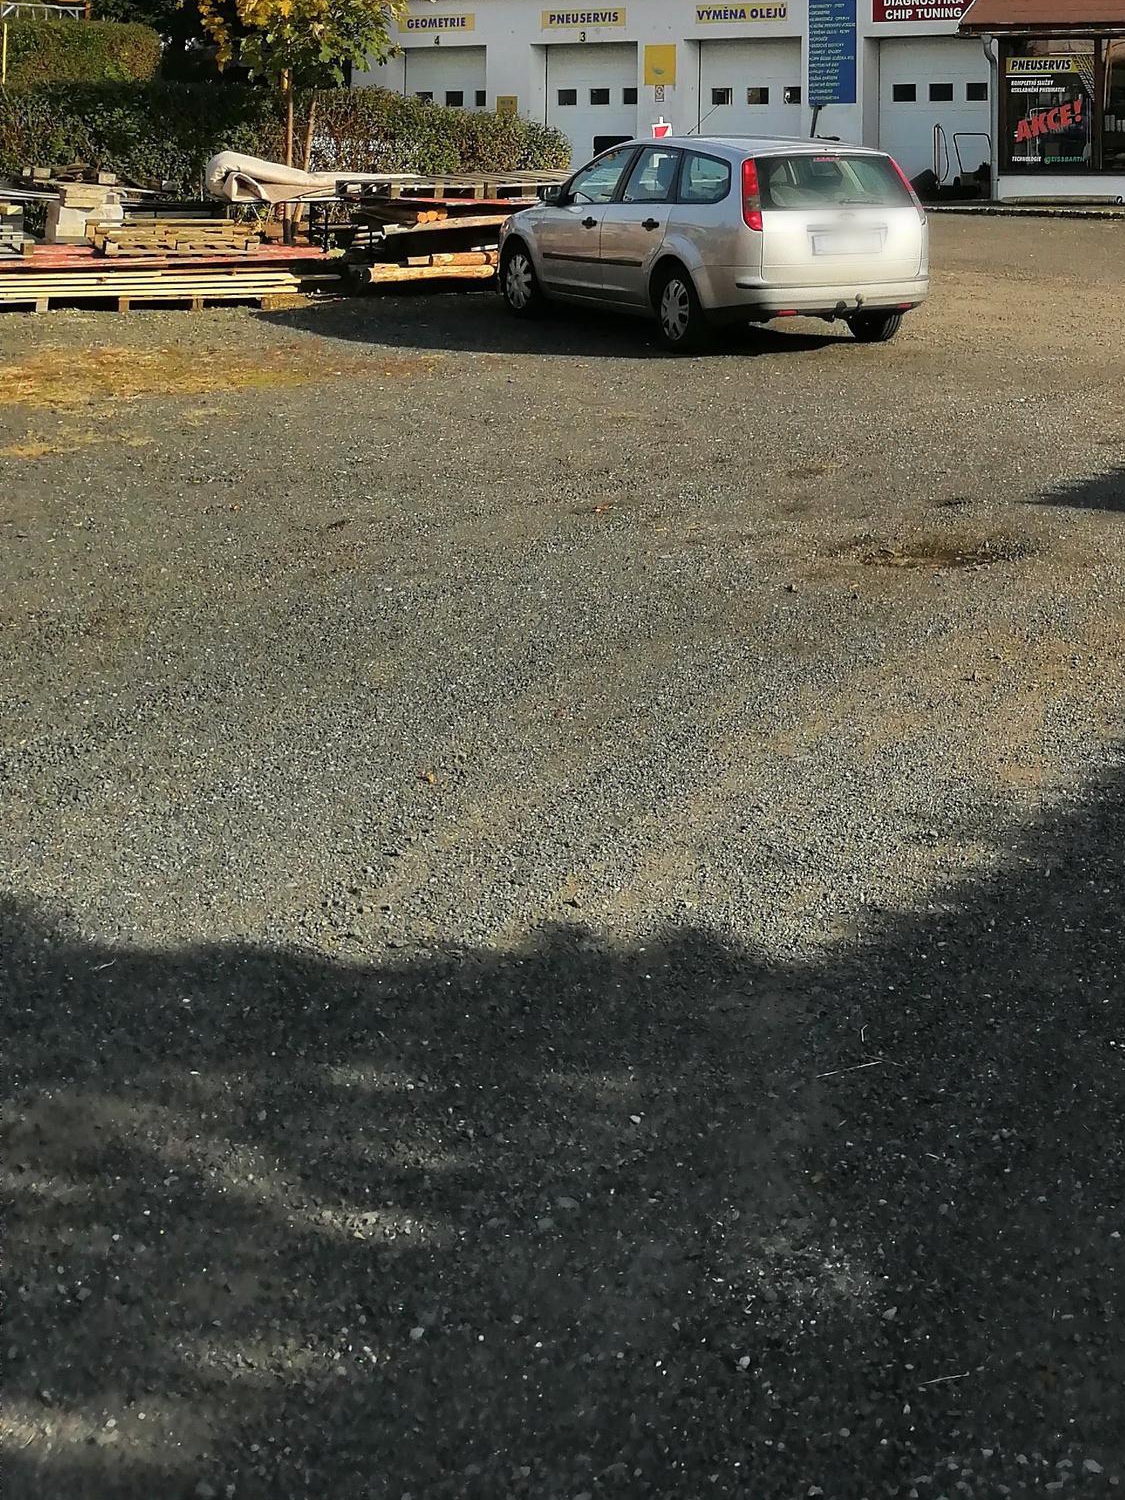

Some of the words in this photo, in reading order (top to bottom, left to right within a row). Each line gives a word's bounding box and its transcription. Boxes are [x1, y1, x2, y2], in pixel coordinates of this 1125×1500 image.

[549, 12, 619, 25] PNEUSERVIS
[697, 6, 746, 21] VÝMĚNA
[750, 4, 787, 19] OLEJŮ
[885, 8, 913, 20] CHIP
[916, 7, 962, 19] TUNING
[407, 17, 466, 29] GEOMETRIE
[434, 36, 440, 46] 4
[580, 32, 586, 42] 3
[1011, 59, 1071, 71] PNEUSERVIS
[1015, 99, 1082, 143] AKCE!
